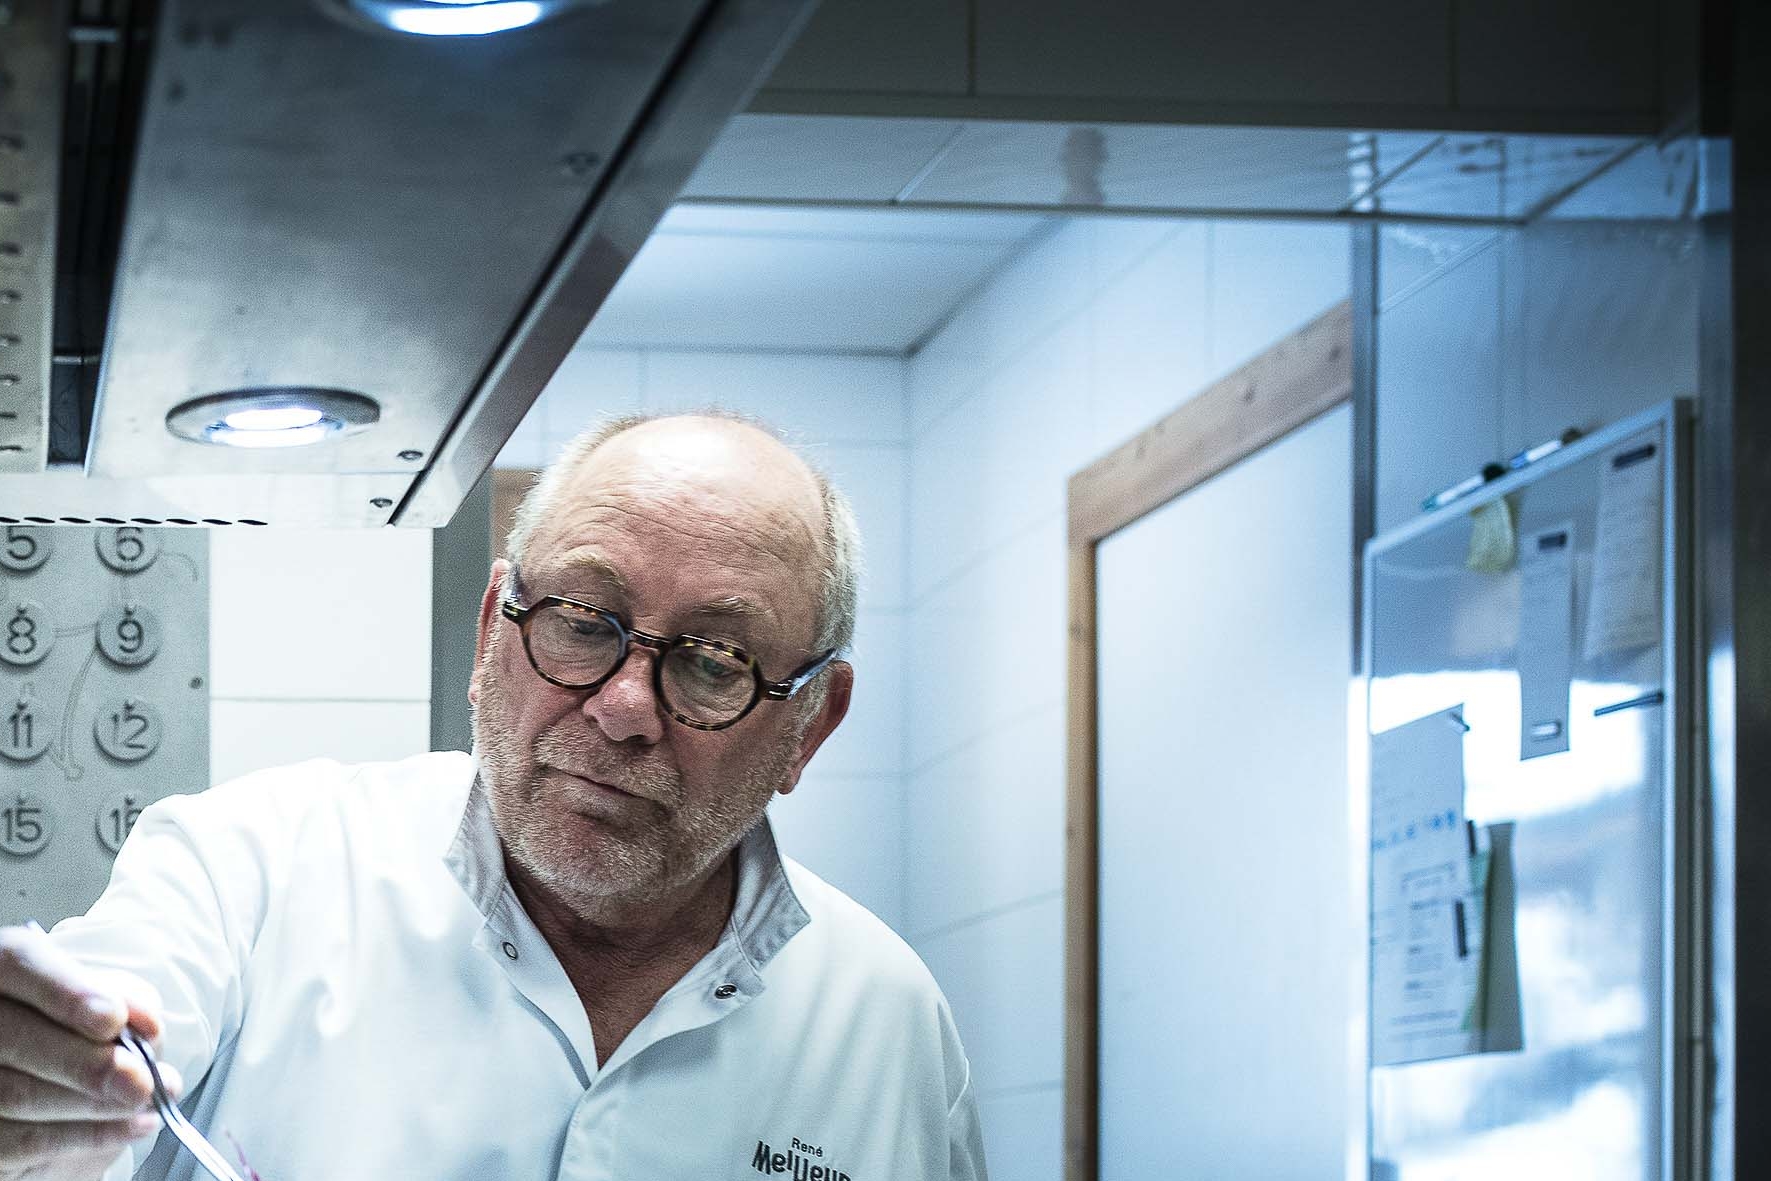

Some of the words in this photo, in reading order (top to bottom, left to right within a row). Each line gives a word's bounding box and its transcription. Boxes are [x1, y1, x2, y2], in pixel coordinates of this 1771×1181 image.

[6, 525, 37, 561] 5
[114, 527, 145, 562] 6
[6, 616, 37, 654] 8
[116, 618, 145, 654] 9
[7, 711, 34, 748] 11
[110, 712, 150, 750] 12
[1, 806, 43, 843] 15
[791, 1136, 824, 1158] René
